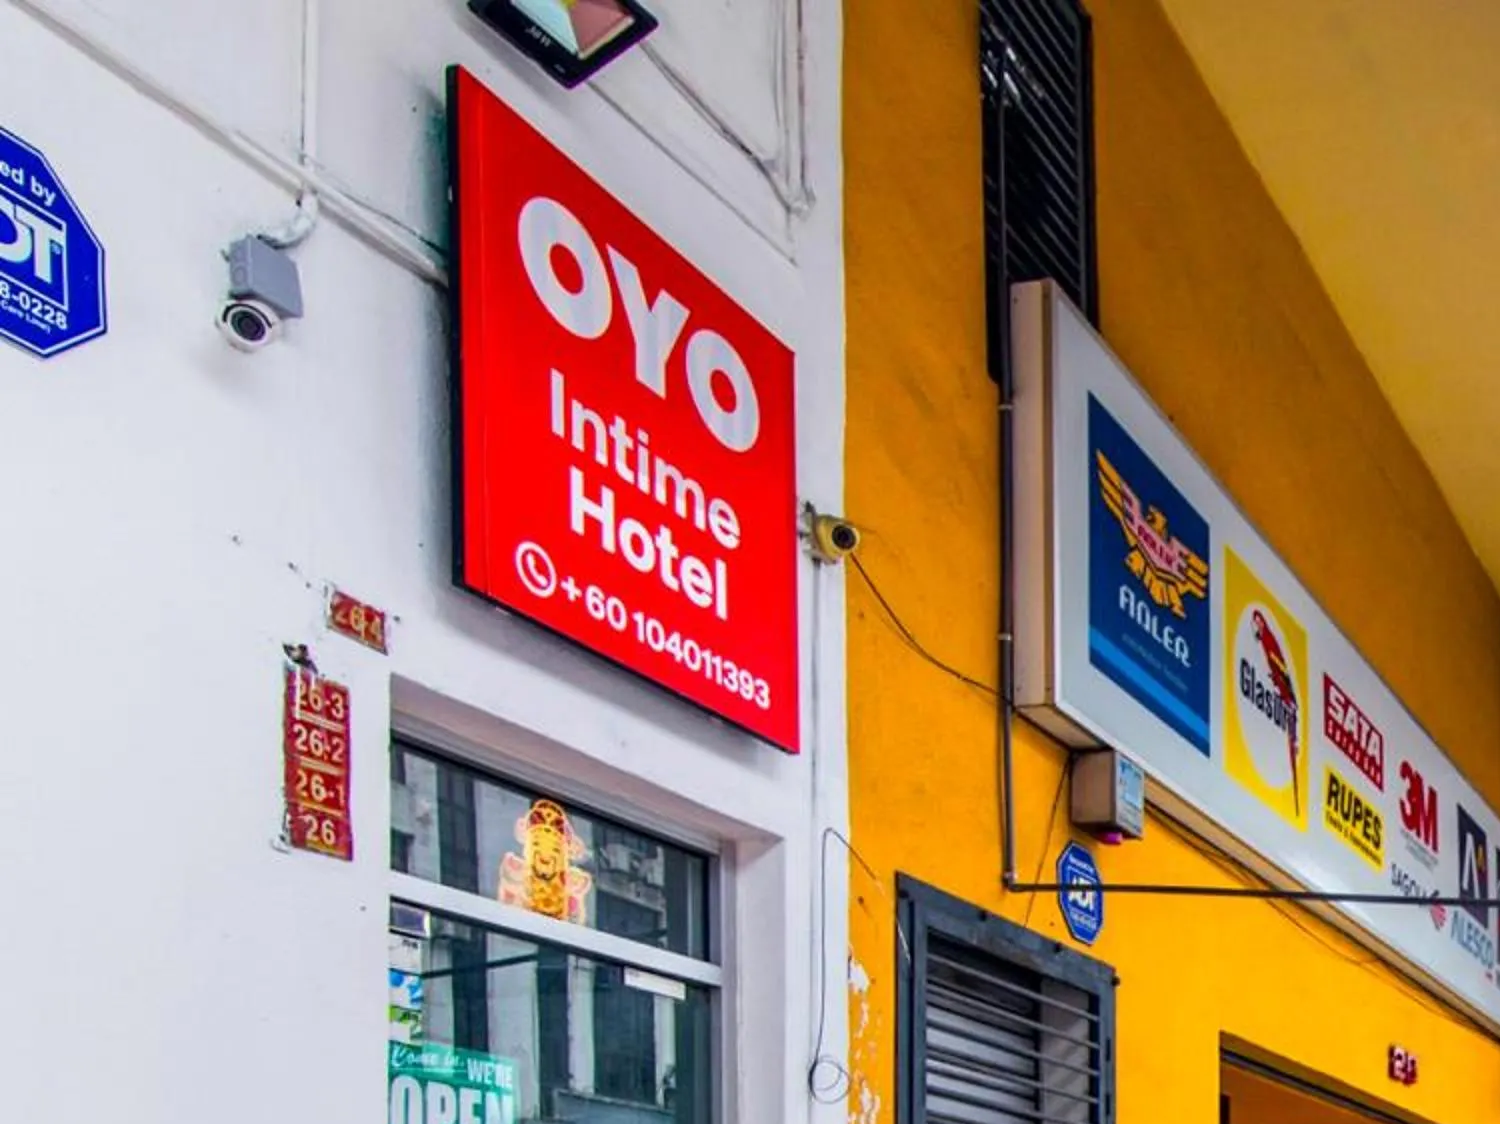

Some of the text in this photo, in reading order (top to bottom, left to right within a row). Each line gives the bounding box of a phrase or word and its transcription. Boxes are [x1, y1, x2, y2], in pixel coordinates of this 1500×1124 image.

[31, 175, 57, 207] by
[518, 196, 761, 453] OYO
[550, 367, 741, 549] Intime
[570, 465, 728, 621] Hotel
[632, 611, 771, 710] 104011393
[1119, 583, 1192, 668] ADLER
[297, 678, 345, 718] 26-3
[1328, 685, 1381, 766] SATA
[293, 724, 345, 763] 26-2
[295, 769, 345, 806] 26-1
[1326, 772, 1382, 850] RUPES
[1399, 760, 1439, 854] 3M
[305, 813, 336, 845] 26
